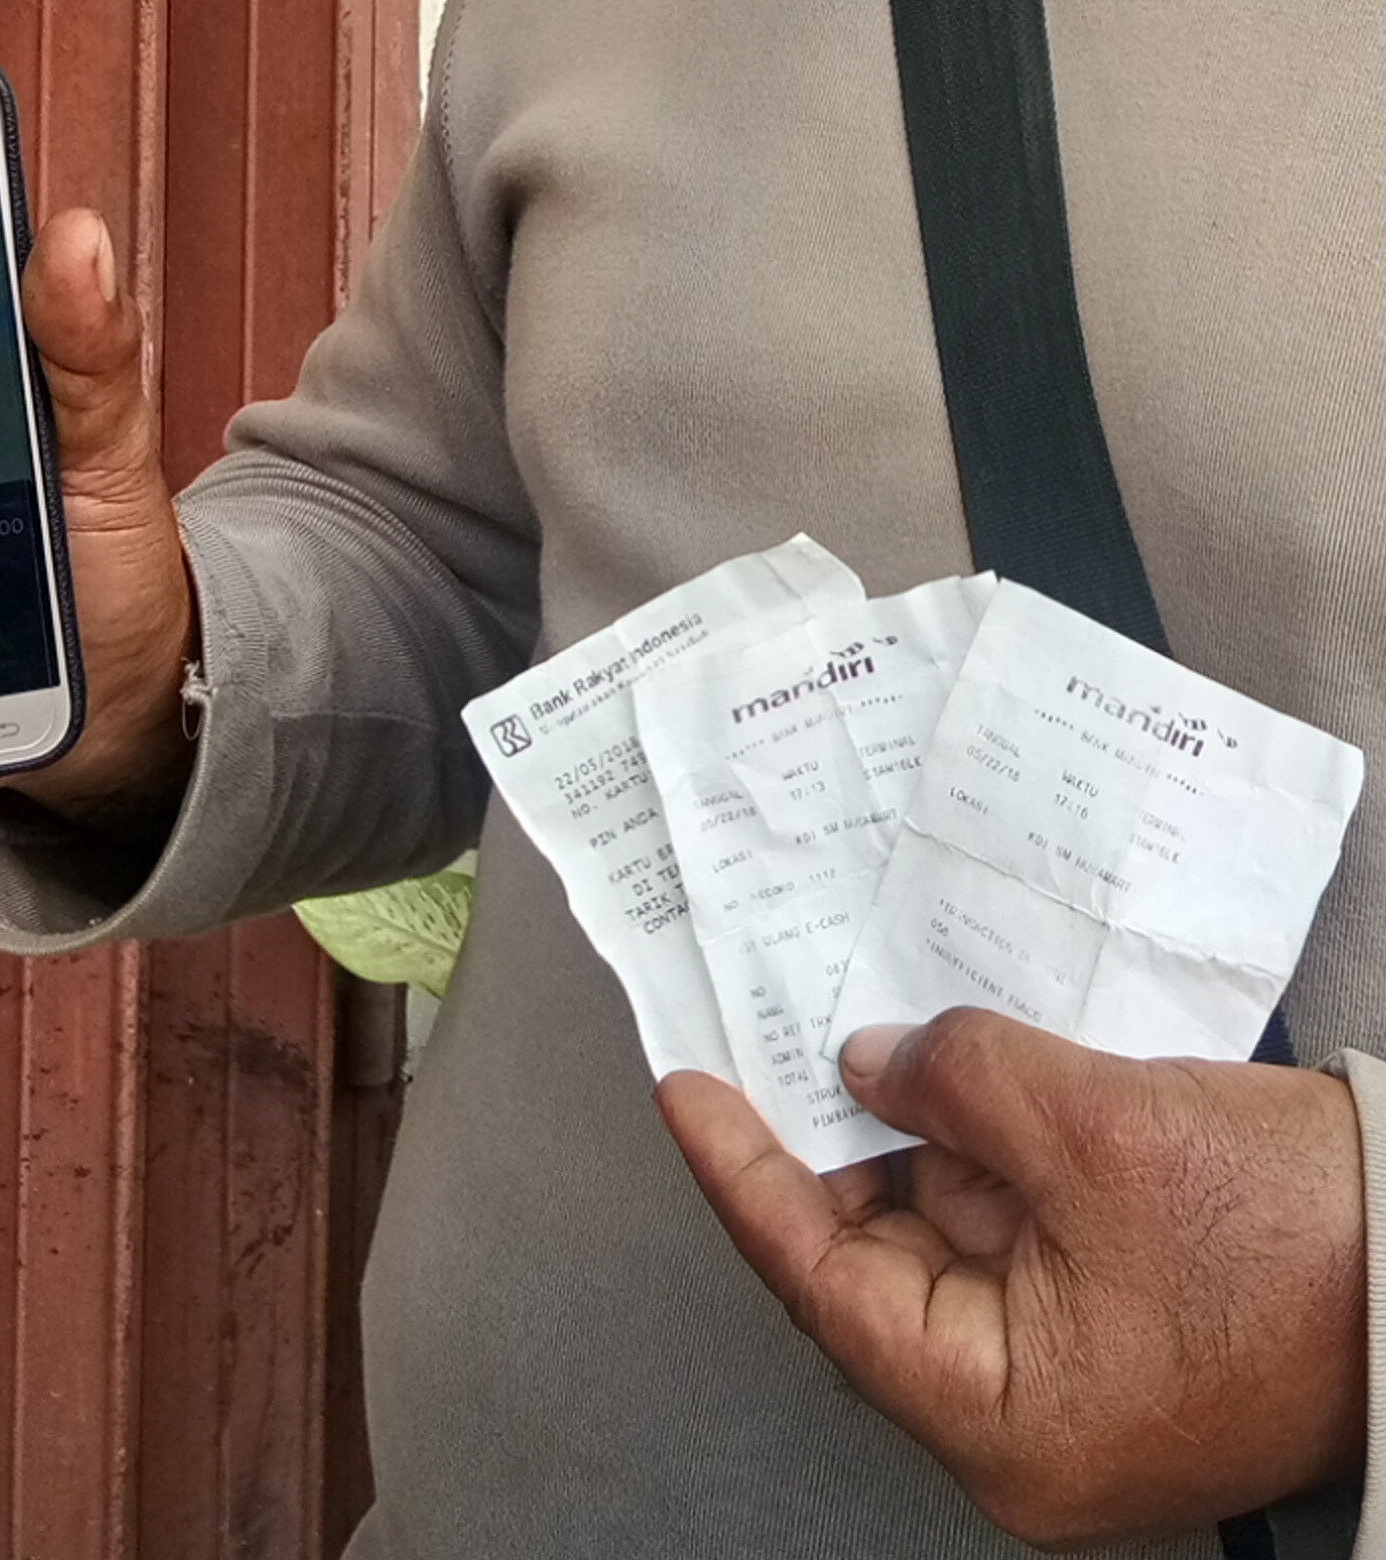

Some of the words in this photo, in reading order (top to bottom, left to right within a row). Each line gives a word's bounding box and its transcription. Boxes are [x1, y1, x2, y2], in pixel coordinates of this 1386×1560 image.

[530, 689, 573, 721] Bank
[572, 654, 629, 697] Rakyat
[630, 611, 703, 666] Indonesia
[731, 656, 875, 724] mandiri
[1066, 675, 1205, 757] mandiri
[949, 785, 989, 815] LOKASI
[589, 828, 617, 849] PIN
[608, 856, 653, 884] KARTU
[632, 878, 653, 897] DI
[624, 893, 672, 921] TARIK
[805, 912, 851, 935] E-CASH
